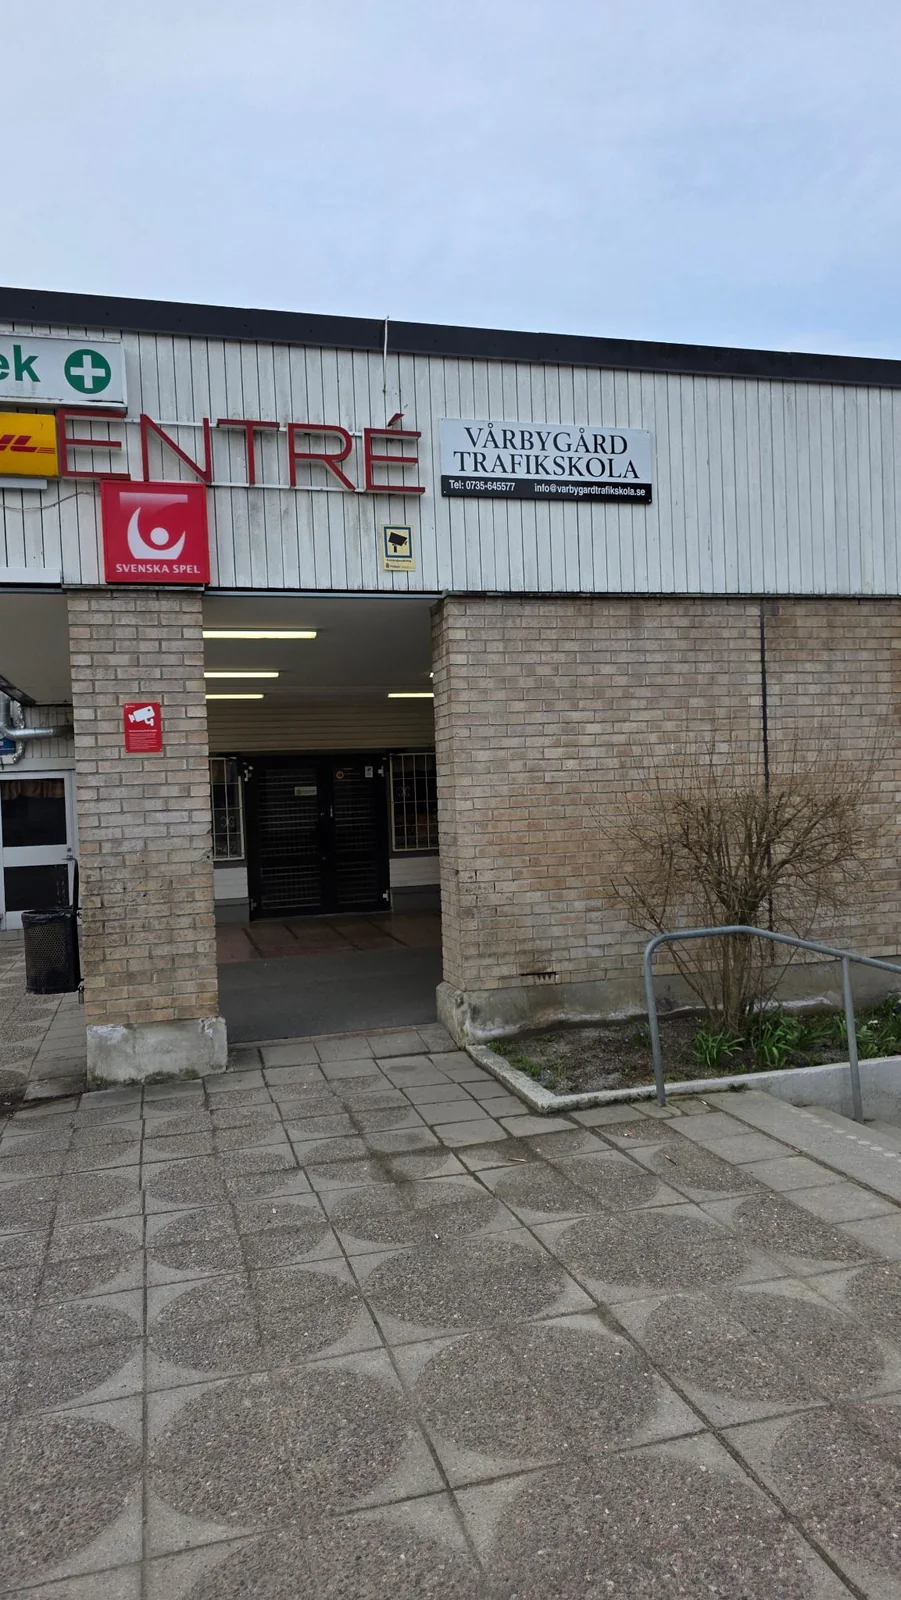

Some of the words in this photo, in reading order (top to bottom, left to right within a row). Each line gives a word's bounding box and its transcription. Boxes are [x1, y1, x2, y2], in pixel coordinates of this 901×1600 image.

[463, 422, 628, 455] VÅRBYGÅRD
[57, 408, 426, 495] ENTRÉ
[453, 451, 640, 479] TRAFIKSKOLA
[449, 479, 464, 490] Tel:
[465, 480, 516, 492] 0735-645577
[534, 483, 646, 496] info@varbygardtrafikskola.se
[116, 563, 170, 574] SVENSKA
[172, 564, 201, 574] SPEL
